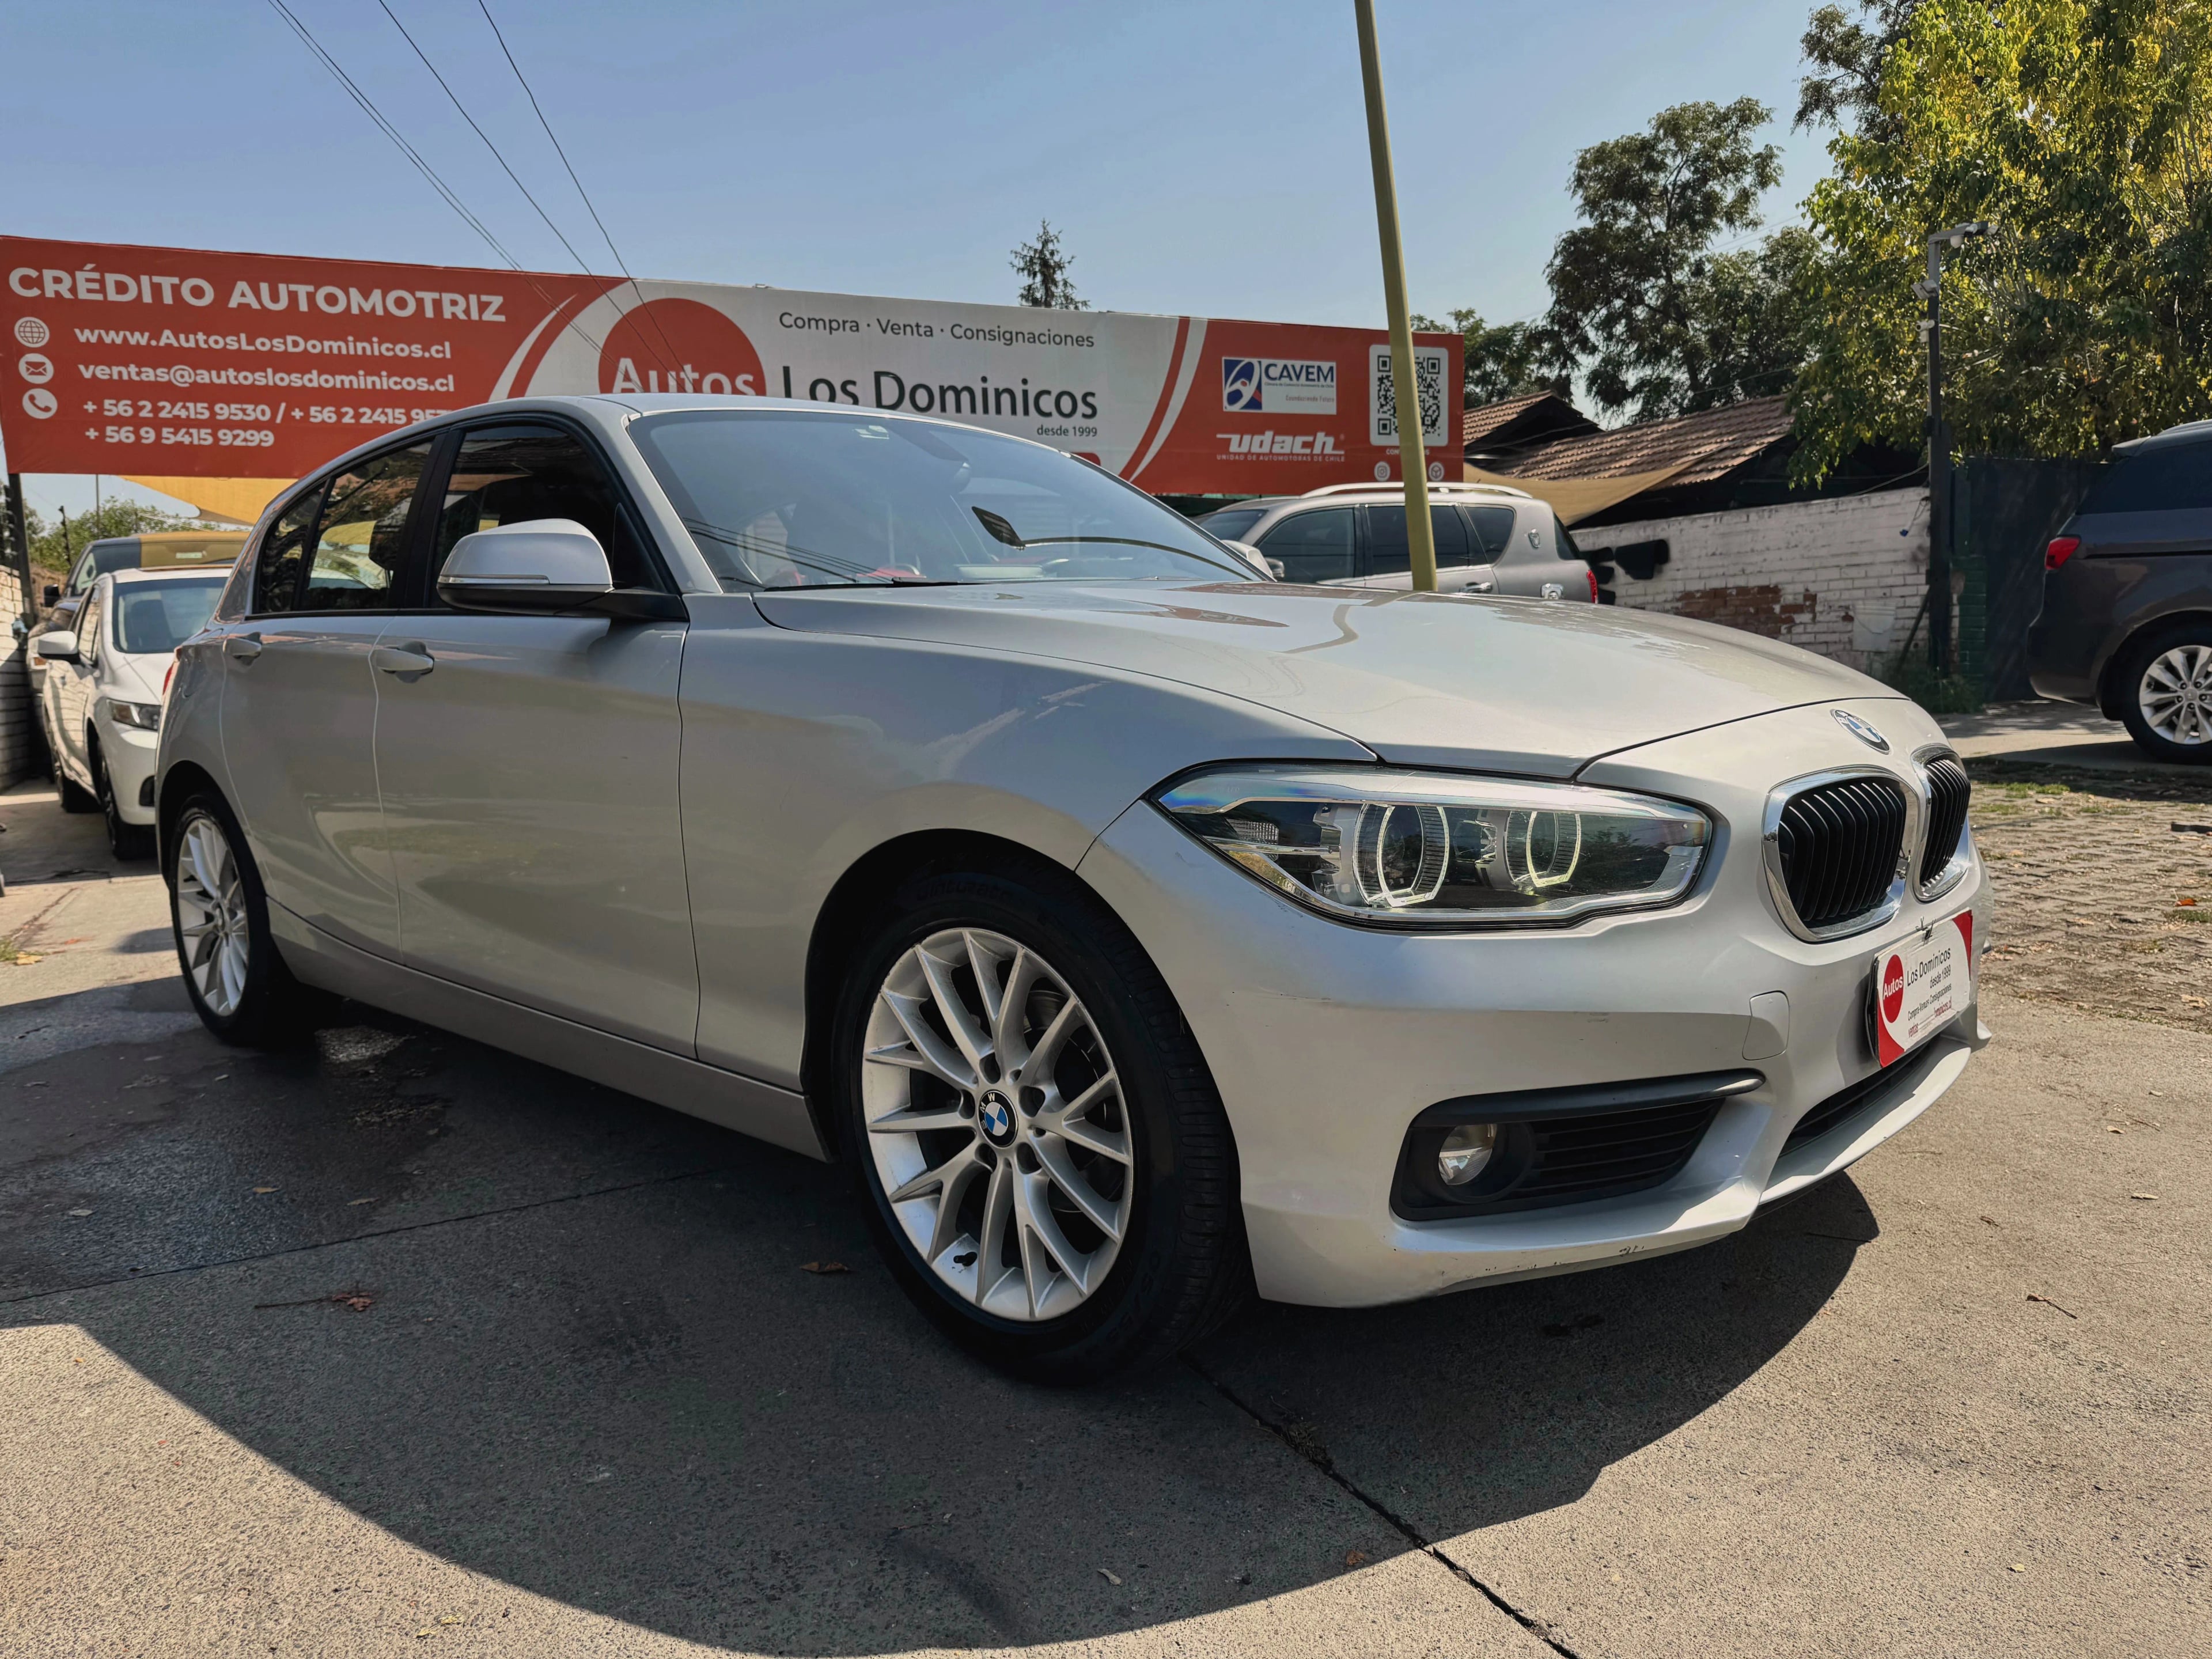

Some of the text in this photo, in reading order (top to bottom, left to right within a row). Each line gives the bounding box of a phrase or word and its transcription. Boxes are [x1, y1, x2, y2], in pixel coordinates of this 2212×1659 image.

[9, 263, 506, 322] CRÉDITO AUTOMOTRIZ
[74, 328, 451, 359] www.AutosLosDominicos.cl
[779, 312, 1094, 348] Compra Venta Consignaciones
[78, 363, 454, 392] ventas@autoslosdominicos.cl
[1264, 363, 1334, 382] CAVEM
[612, 357, 1098, 420] Autos Los Dominicos
[104, 399, 134, 417] 56
[138, 400, 154, 418] 2
[157, 401, 210, 419] 2415
[214, 403, 271, 421] 9530
[275, 402, 287, 424] /
[309, 406, 338, 423] 56
[340, 407, 355, 424] 2
[359, 407, 407, 425] 2415
[105, 426, 135, 444] 56
[140, 426, 156, 444] 9
[161, 427, 214, 445] 5415
[218, 429, 275, 447] 9299
[1036, 424, 1097, 437] desde 1999
[1216, 430, 1345, 454] udach
[1907, 948, 1951, 987] Los Dominicos
[1930, 971, 1941, 989] desde
[1883, 976, 1903, 1001] Autos
[979, 1093, 995, 1130] BMW
